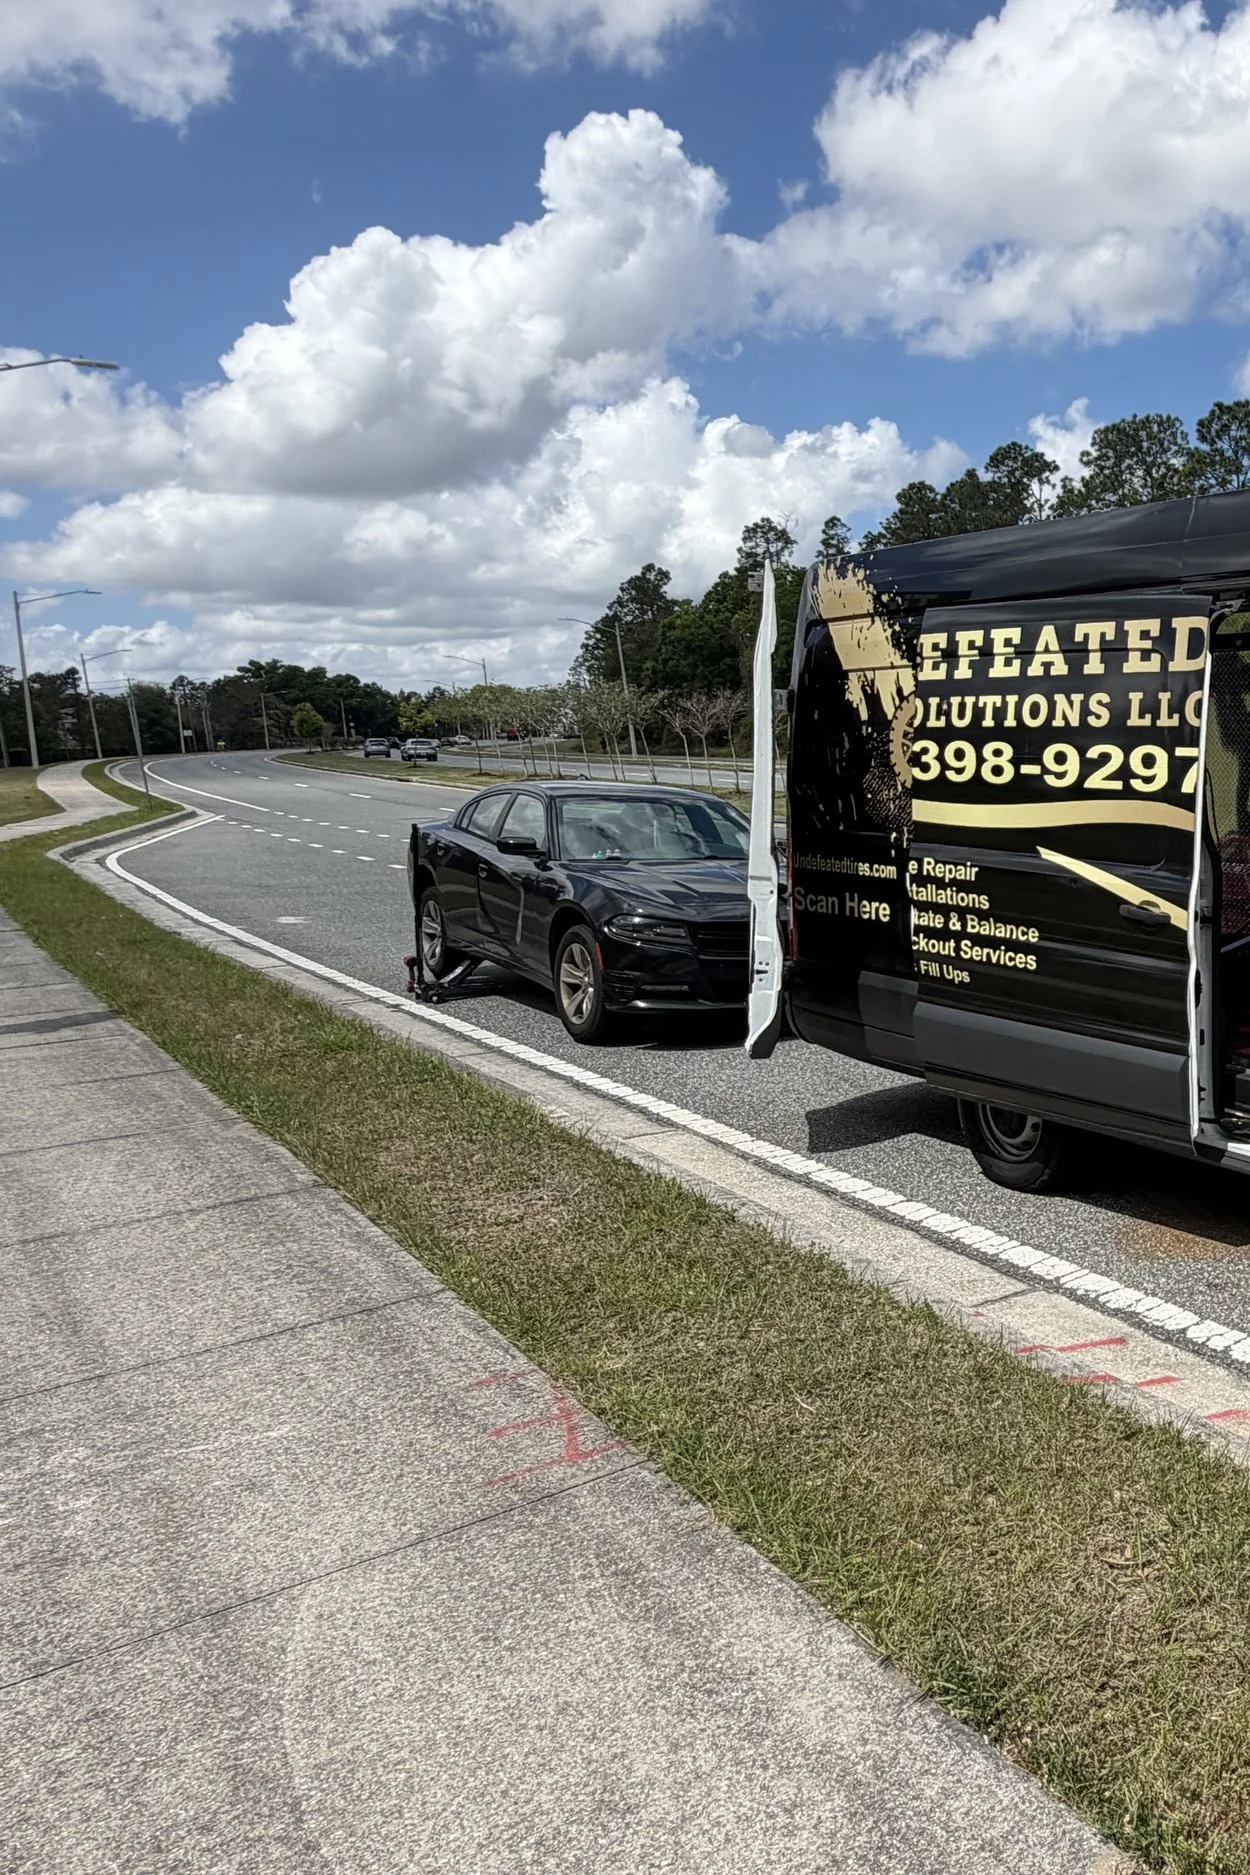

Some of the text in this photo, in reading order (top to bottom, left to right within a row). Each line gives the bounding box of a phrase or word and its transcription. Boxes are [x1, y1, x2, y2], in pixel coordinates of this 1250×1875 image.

[917, 616, 1209, 681] EFEATED
[911, 740, 1199, 793] 398-9297
[793, 852, 897, 880] Undefeatedtires.com
[923, 858, 979, 883] Repair
[794, 886, 891, 922] Scan Here
[911, 884, 990, 910] tallations
[949, 912, 962, 931] &
[966, 914, 1040, 943] Balance
[911, 933, 1037, 970] ckout Services
[919, 960, 941, 978] Fill
[943, 964, 971, 985] Ups
